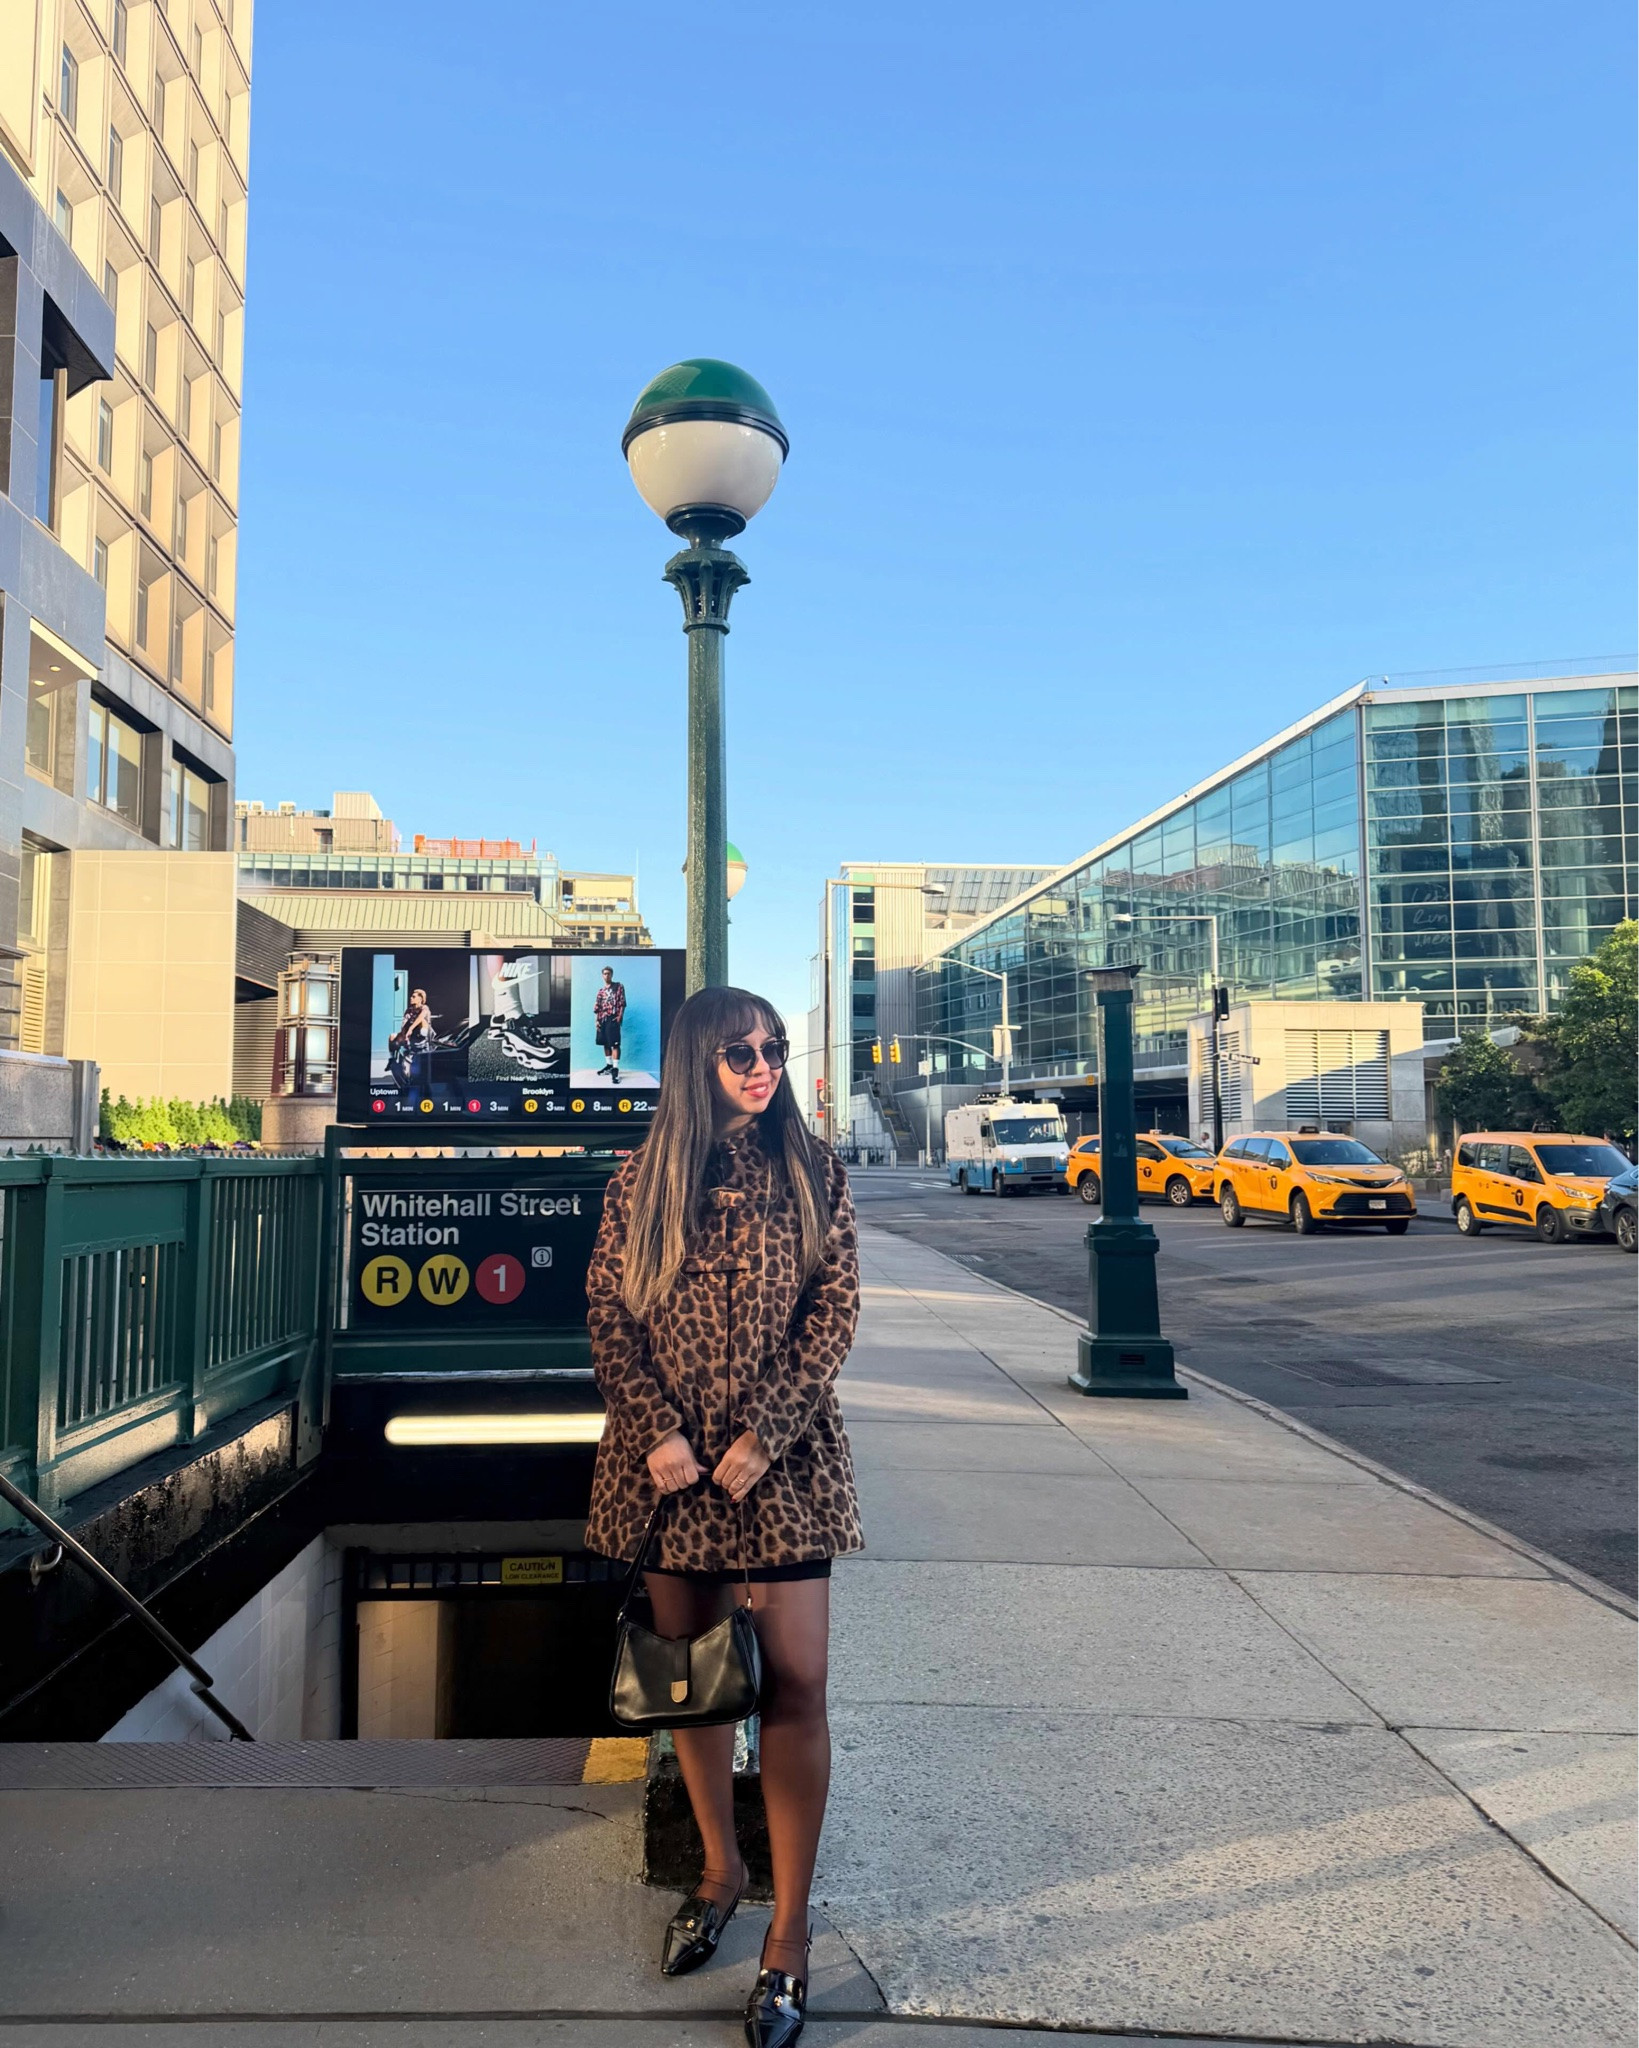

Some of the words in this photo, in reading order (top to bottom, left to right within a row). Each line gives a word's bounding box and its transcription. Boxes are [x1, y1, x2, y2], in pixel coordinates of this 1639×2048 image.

[1413, 909, 1449, 924] Run
[499, 963, 532, 978] NIKE
[1435, 1002, 1471, 1015] AND
[370, 1088, 398, 1096] Uptown
[522, 1087, 554, 1096] Brooklyn
[395, 1101, 401, 1111] 1
[443, 1101, 449, 1111] 1
[489, 1101, 497, 1111] 3
[546, 1101, 554, 1111] 3
[593, 1101, 601, 1111] 8
[633, 1101, 647, 1111] 22
[361, 1194, 491, 1217] Whitehall
[500, 1193, 581, 1216] Street
[361, 1222, 460, 1246] Station
[376, 1267, 399, 1293] R
[428, 1267, 461, 1294] W
[493, 1264, 506, 1292] 1
[509, 1562, 556, 1571] CAUTION
